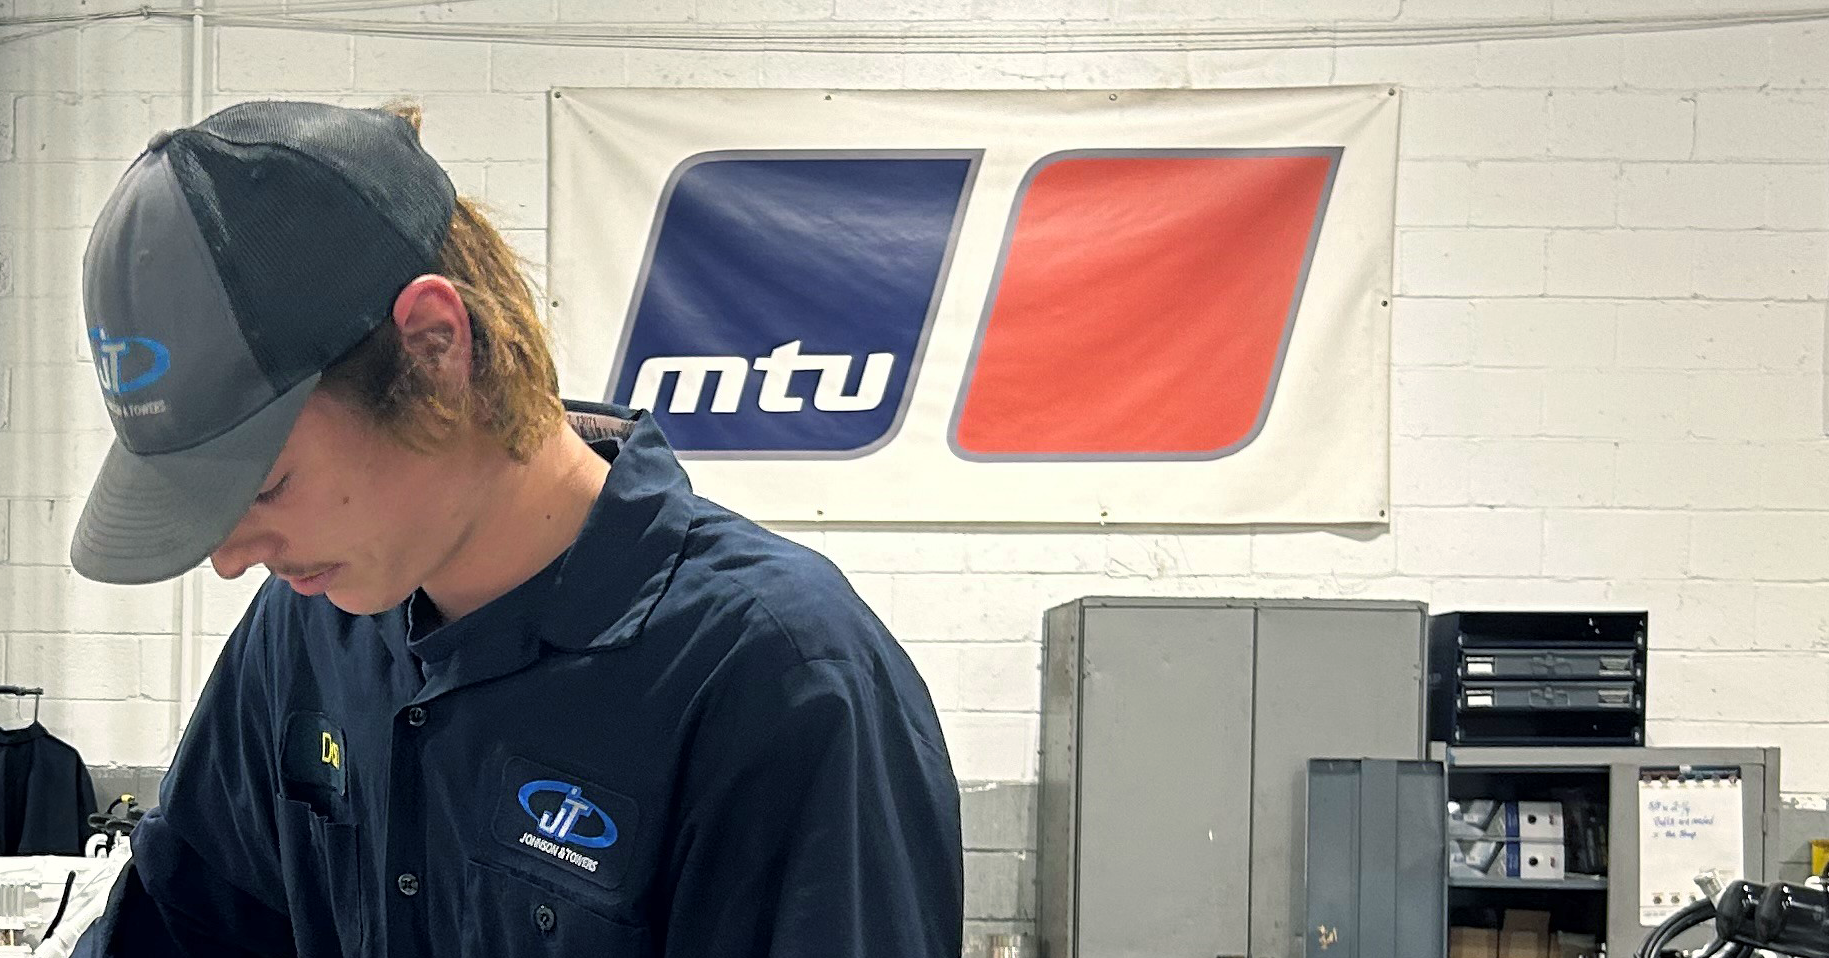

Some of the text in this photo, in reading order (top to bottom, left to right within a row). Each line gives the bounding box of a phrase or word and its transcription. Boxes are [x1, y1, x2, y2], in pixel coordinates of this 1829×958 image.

[629, 339, 894, 413] mtu
[519, 832, 560, 856] JOHNSON
[565, 847, 599, 872] TOWERS
